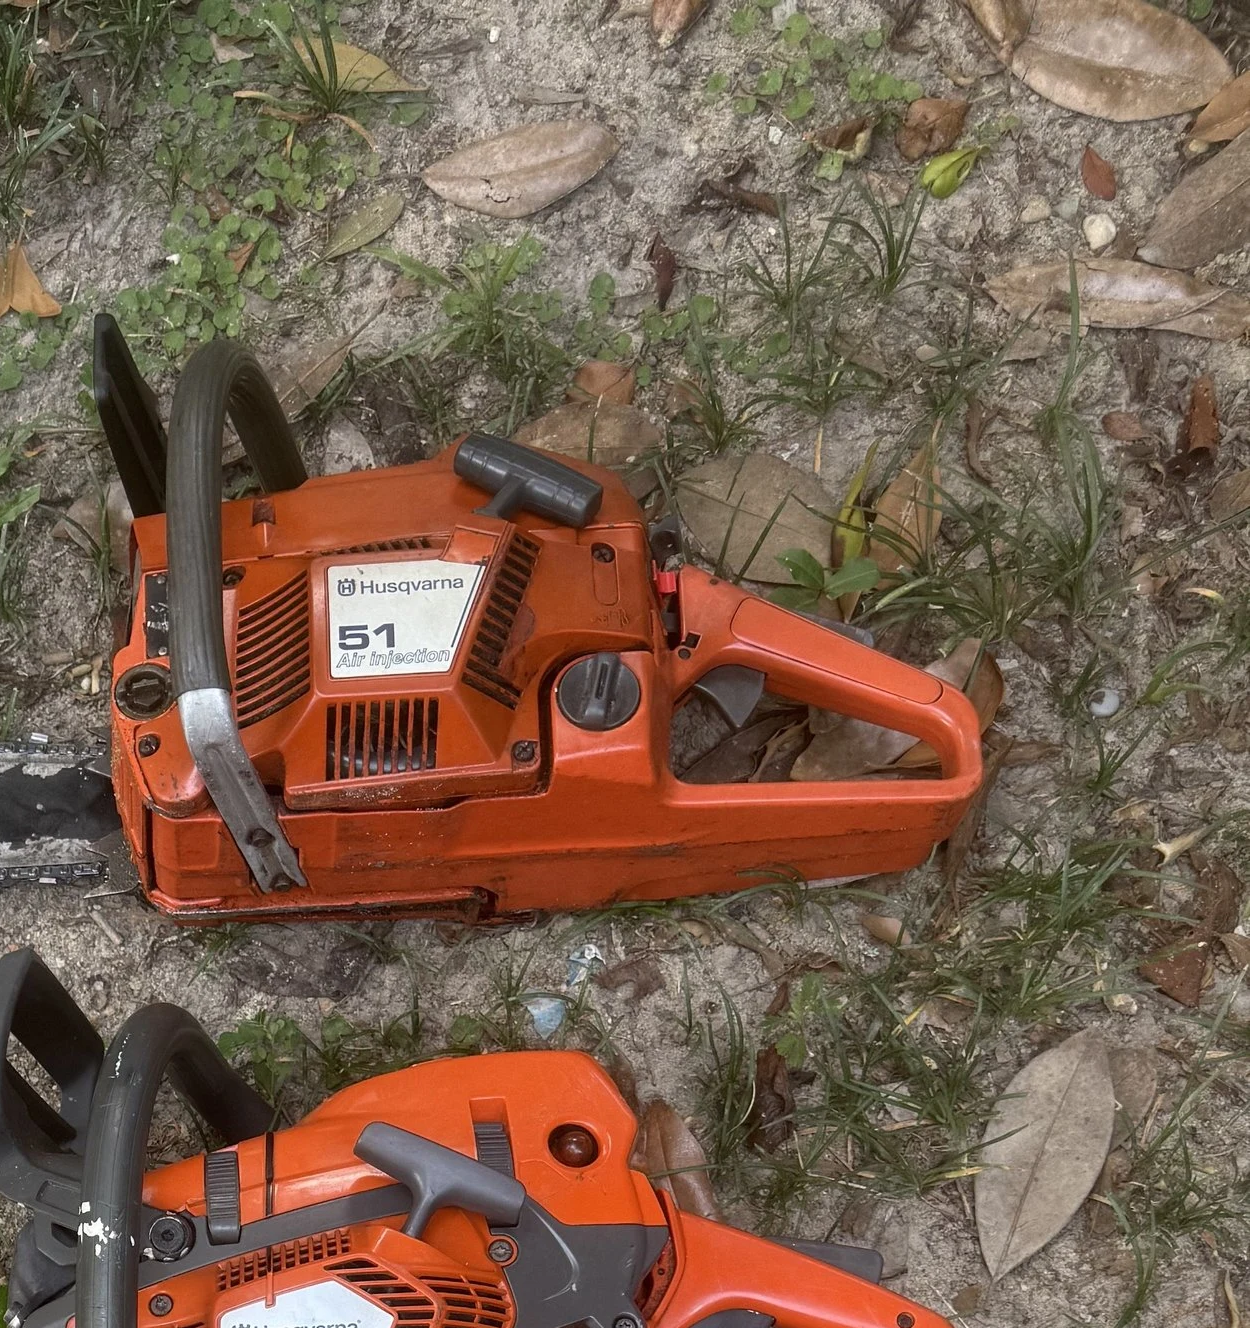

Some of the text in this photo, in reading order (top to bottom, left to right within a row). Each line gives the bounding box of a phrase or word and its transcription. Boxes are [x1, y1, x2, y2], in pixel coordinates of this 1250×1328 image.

[360, 577, 464, 596] Husqvarna
[338, 623, 396, 651] 51
[336, 648, 450, 669] Air injection
